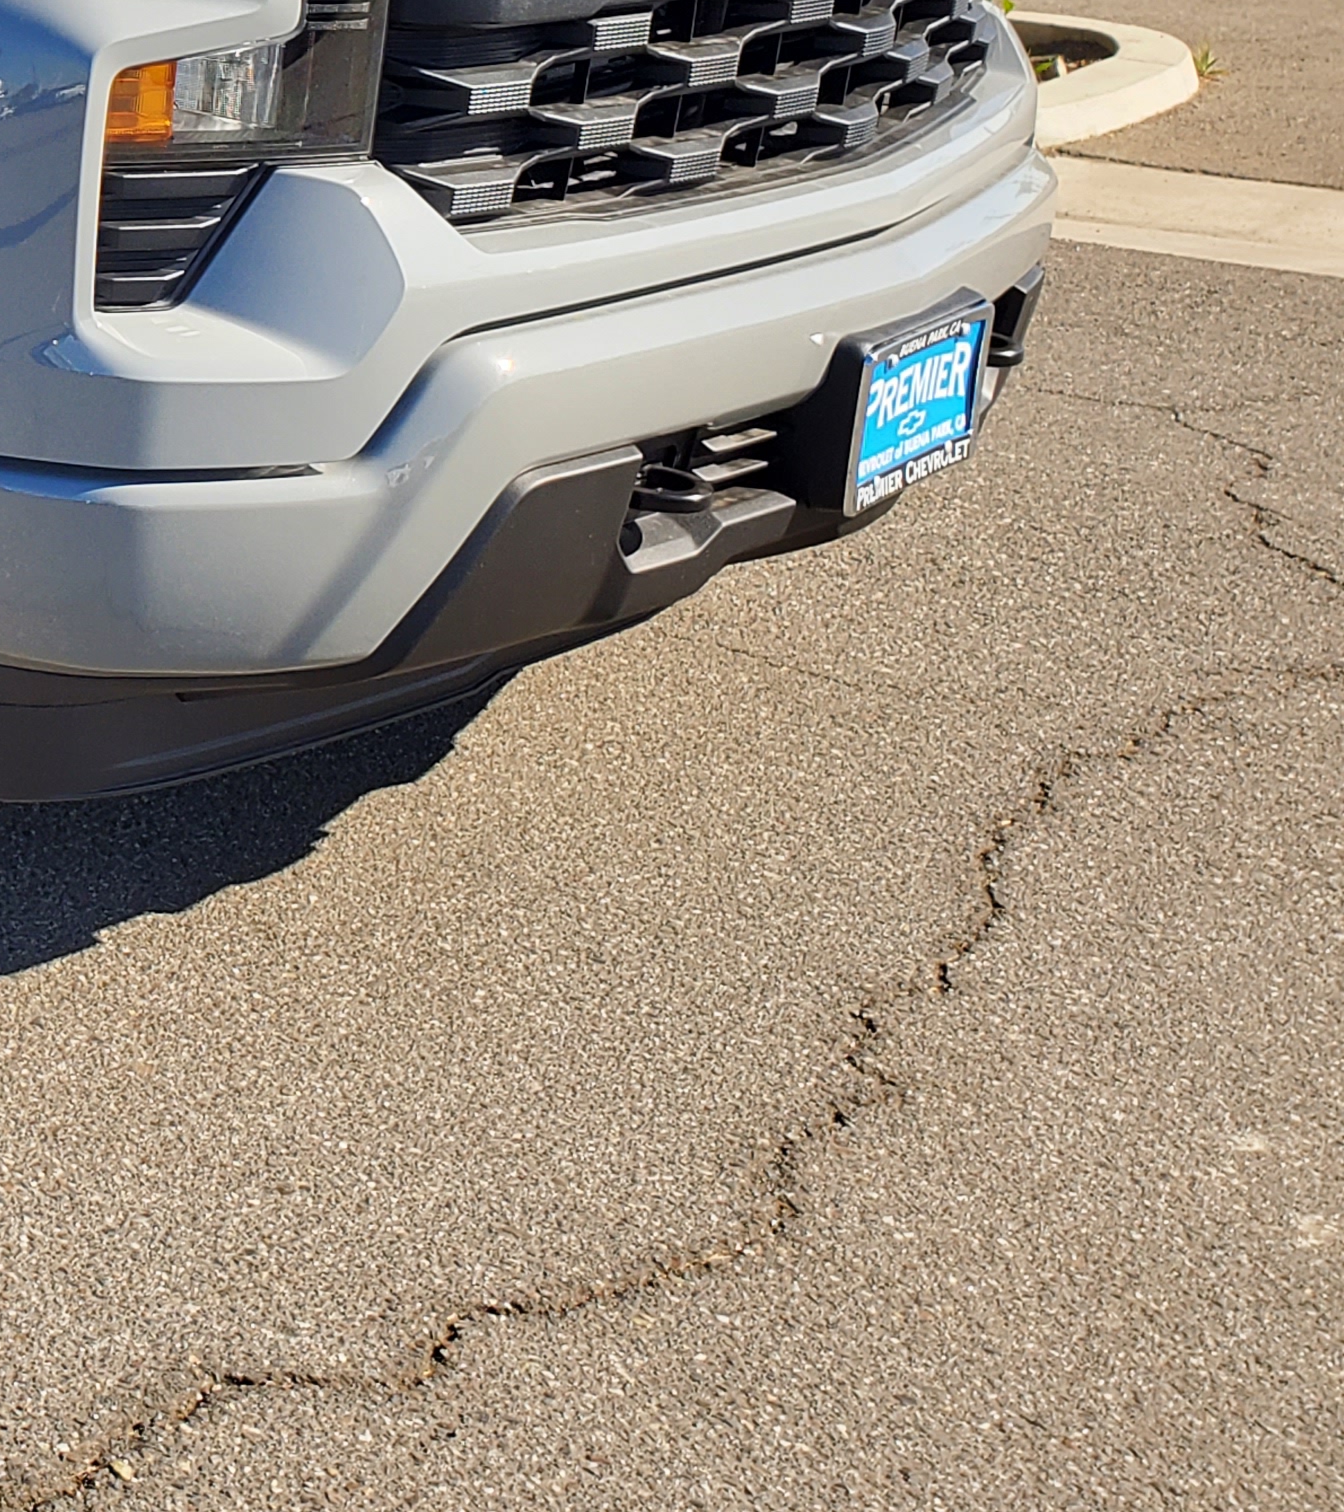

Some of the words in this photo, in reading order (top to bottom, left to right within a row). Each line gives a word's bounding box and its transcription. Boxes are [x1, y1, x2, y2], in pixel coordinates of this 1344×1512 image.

[949, 319, 962, 337] CA
[867, 342, 971, 428] PREMIER
[856, 469, 903, 511] PREMIER
[905, 438, 971, 484] CHEVROLET
